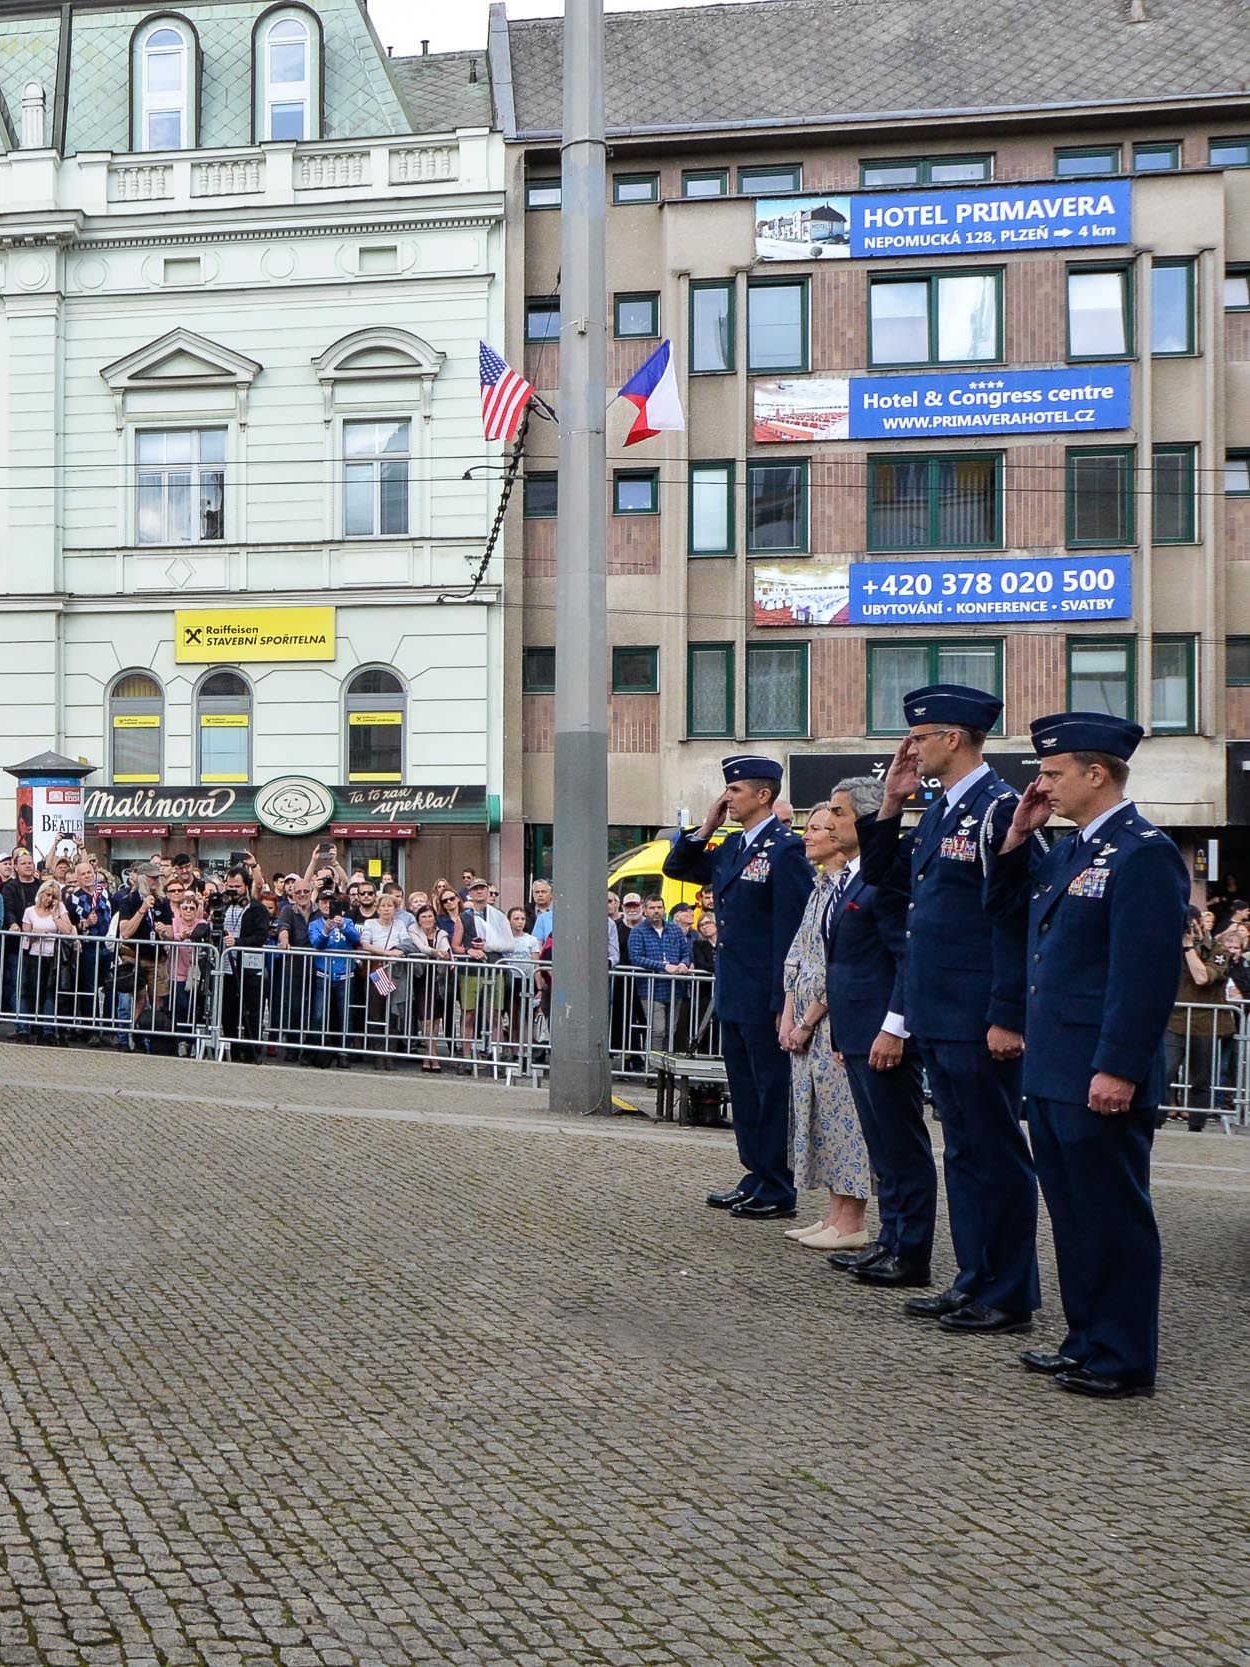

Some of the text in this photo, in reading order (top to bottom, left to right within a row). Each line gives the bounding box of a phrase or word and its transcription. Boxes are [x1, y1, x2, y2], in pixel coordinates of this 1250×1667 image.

[864, 195, 1115, 229] HOTEL PRIMAVERA
[864, 224, 1117, 249] NEPOMUCKÁ 128, PLZEŇ 4 km
[863, 384, 1114, 413] Hotel & Congress centre
[882, 409, 1095, 430] WWW.PRIMAVERAHOTEL.CZ
[863, 569, 1115, 596] +420 378 020 500
[862, 599, 1115, 616] UBYTOVÁNÍ KONFERENCE SVATBY
[206, 625, 259, 635] Raiffeisen
[206, 634, 327, 646] STAVEBNÍ SPOŘITELNA
[871, 762, 942, 789] Žka
[349, 787, 412, 804] Ta to zase
[371, 787, 460, 822] upekla!
